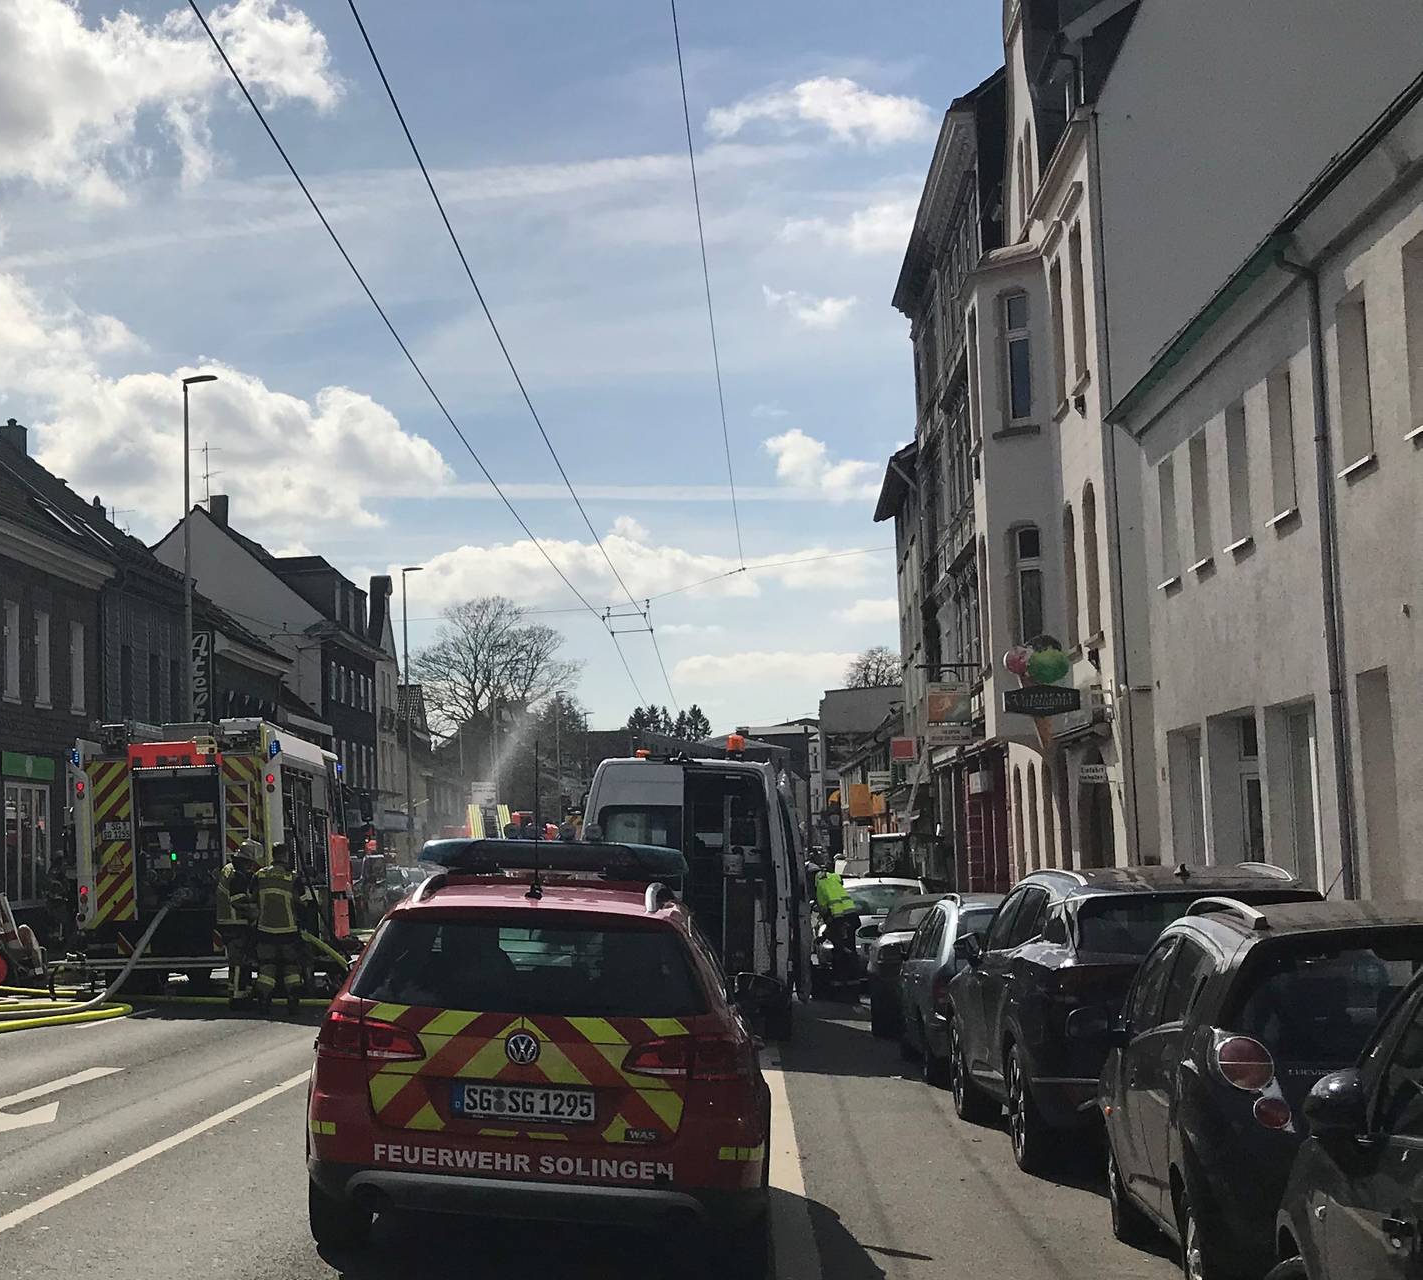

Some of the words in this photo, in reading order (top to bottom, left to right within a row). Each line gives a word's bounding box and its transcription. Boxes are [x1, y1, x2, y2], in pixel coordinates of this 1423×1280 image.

[465, 1087, 492, 1111] SG
[508, 1090, 534, 1114] SG
[539, 1092, 592, 1118] 1295
[374, 1143, 530, 1173] FEUERWEHR
[539, 1155, 674, 1181] SOLINGEN
